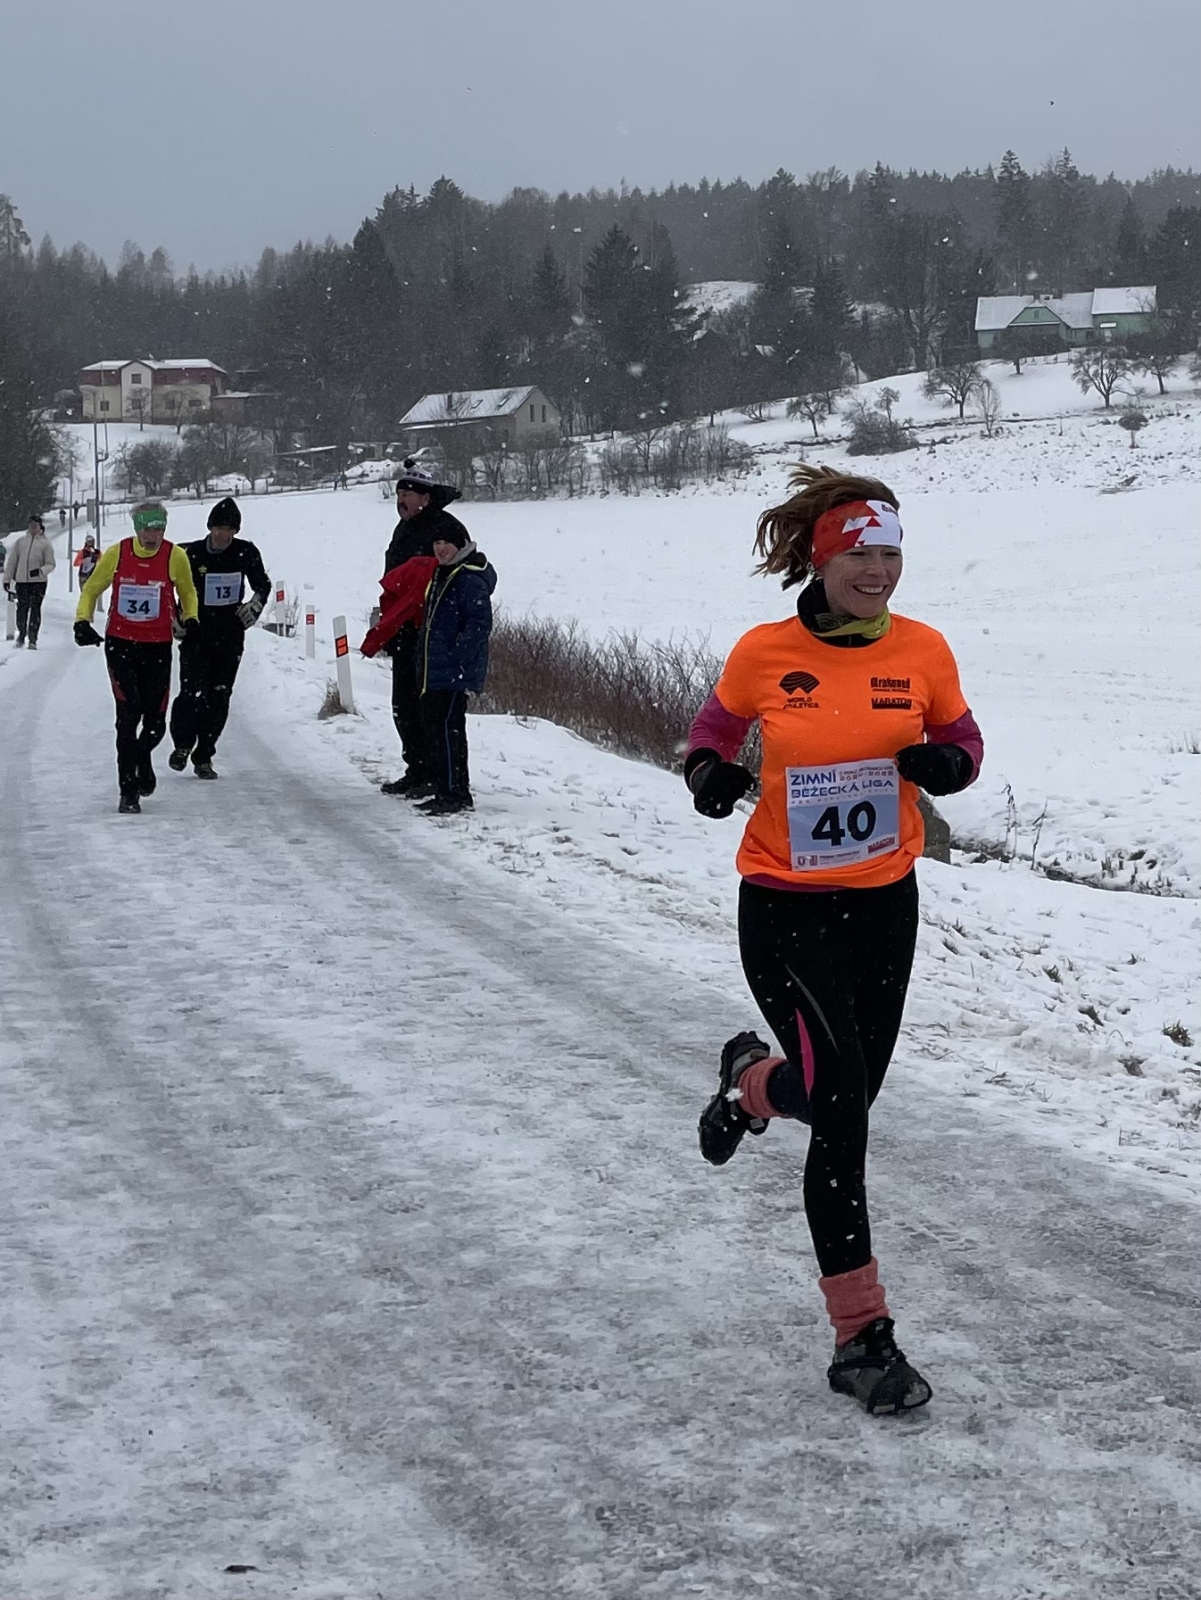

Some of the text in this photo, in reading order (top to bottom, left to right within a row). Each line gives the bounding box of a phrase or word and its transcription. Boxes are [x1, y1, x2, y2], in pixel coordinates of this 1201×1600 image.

[215, 586, 231, 599] 13
[127, 600, 150, 615] 34
[790, 769, 837, 786] ZIMNÍ
[791, 783, 860, 799] BĚŽECKÁ
[862, 779, 894, 789] LIGA
[811, 800, 877, 848] 40
